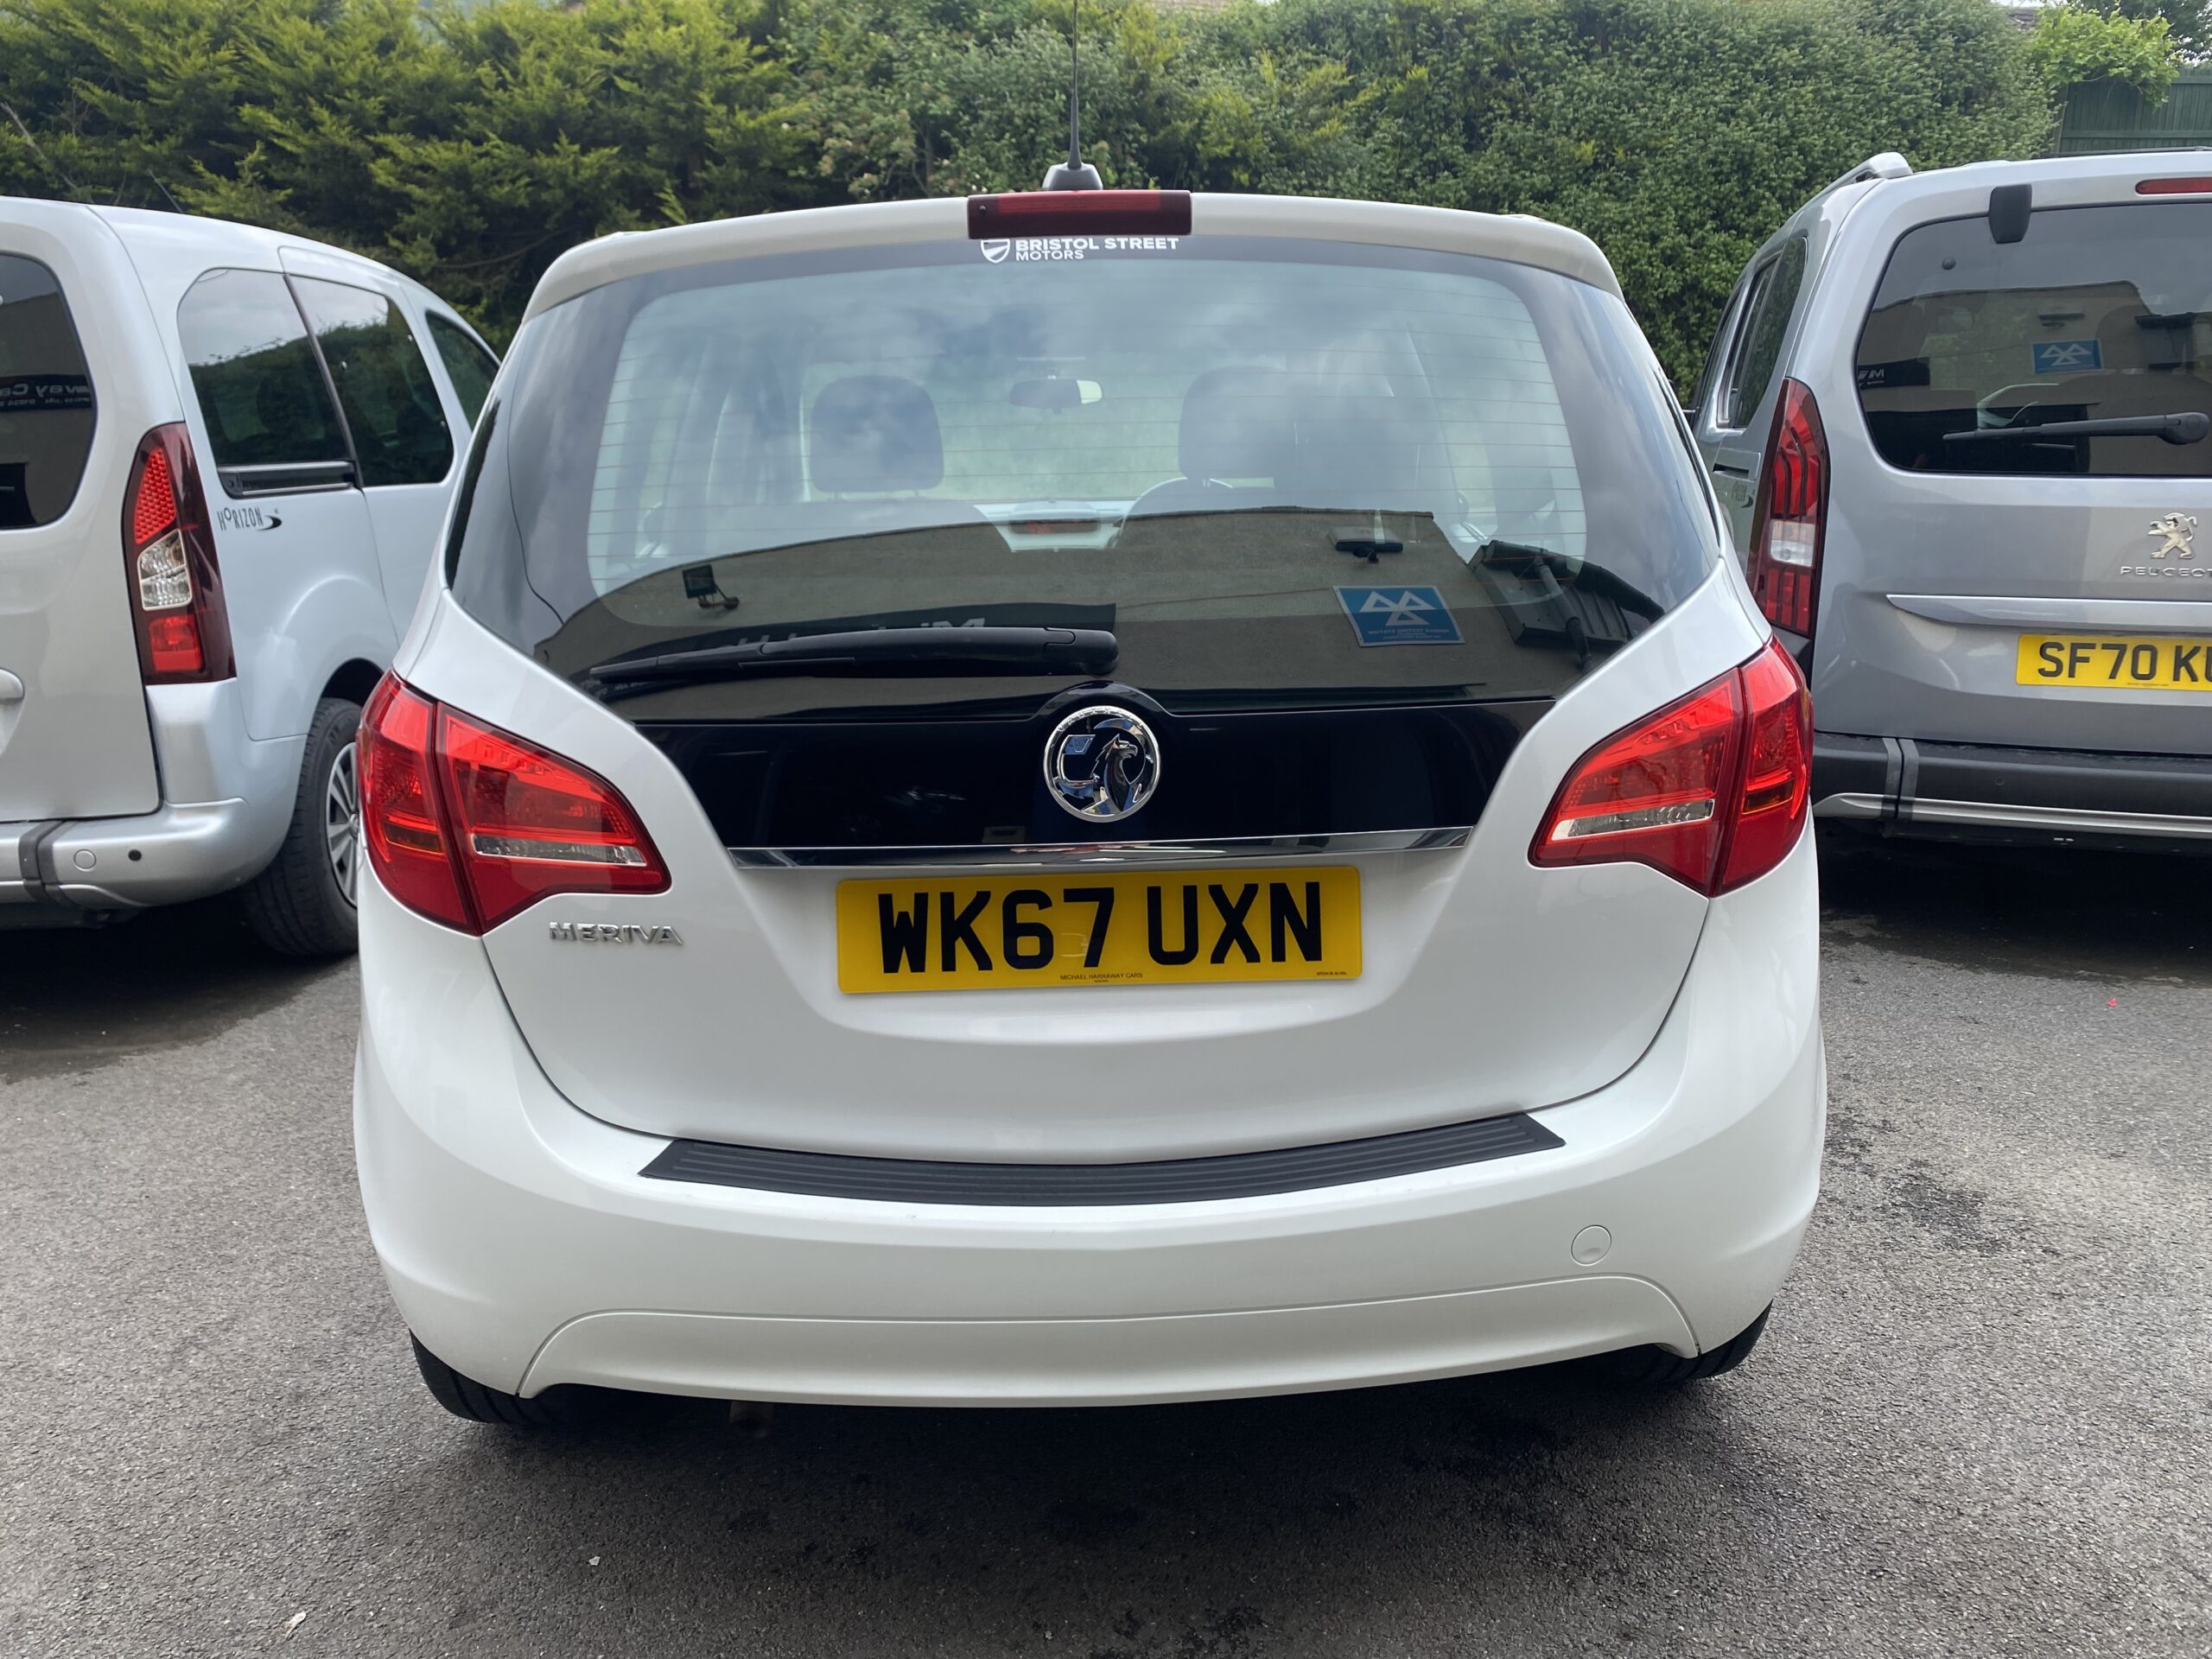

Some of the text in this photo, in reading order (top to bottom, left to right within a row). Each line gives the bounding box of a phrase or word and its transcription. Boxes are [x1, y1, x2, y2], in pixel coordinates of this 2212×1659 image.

[1015, 237, 1179, 251] BRISTOL STREET
[1015, 250, 1084, 261] MOTORS
[216, 506, 264, 531] HORIZON
[2037, 641, 2158, 681] SF70
[550, 921, 683, 945] MERIVA
[878, 881, 1323, 974] WK67 UXN
